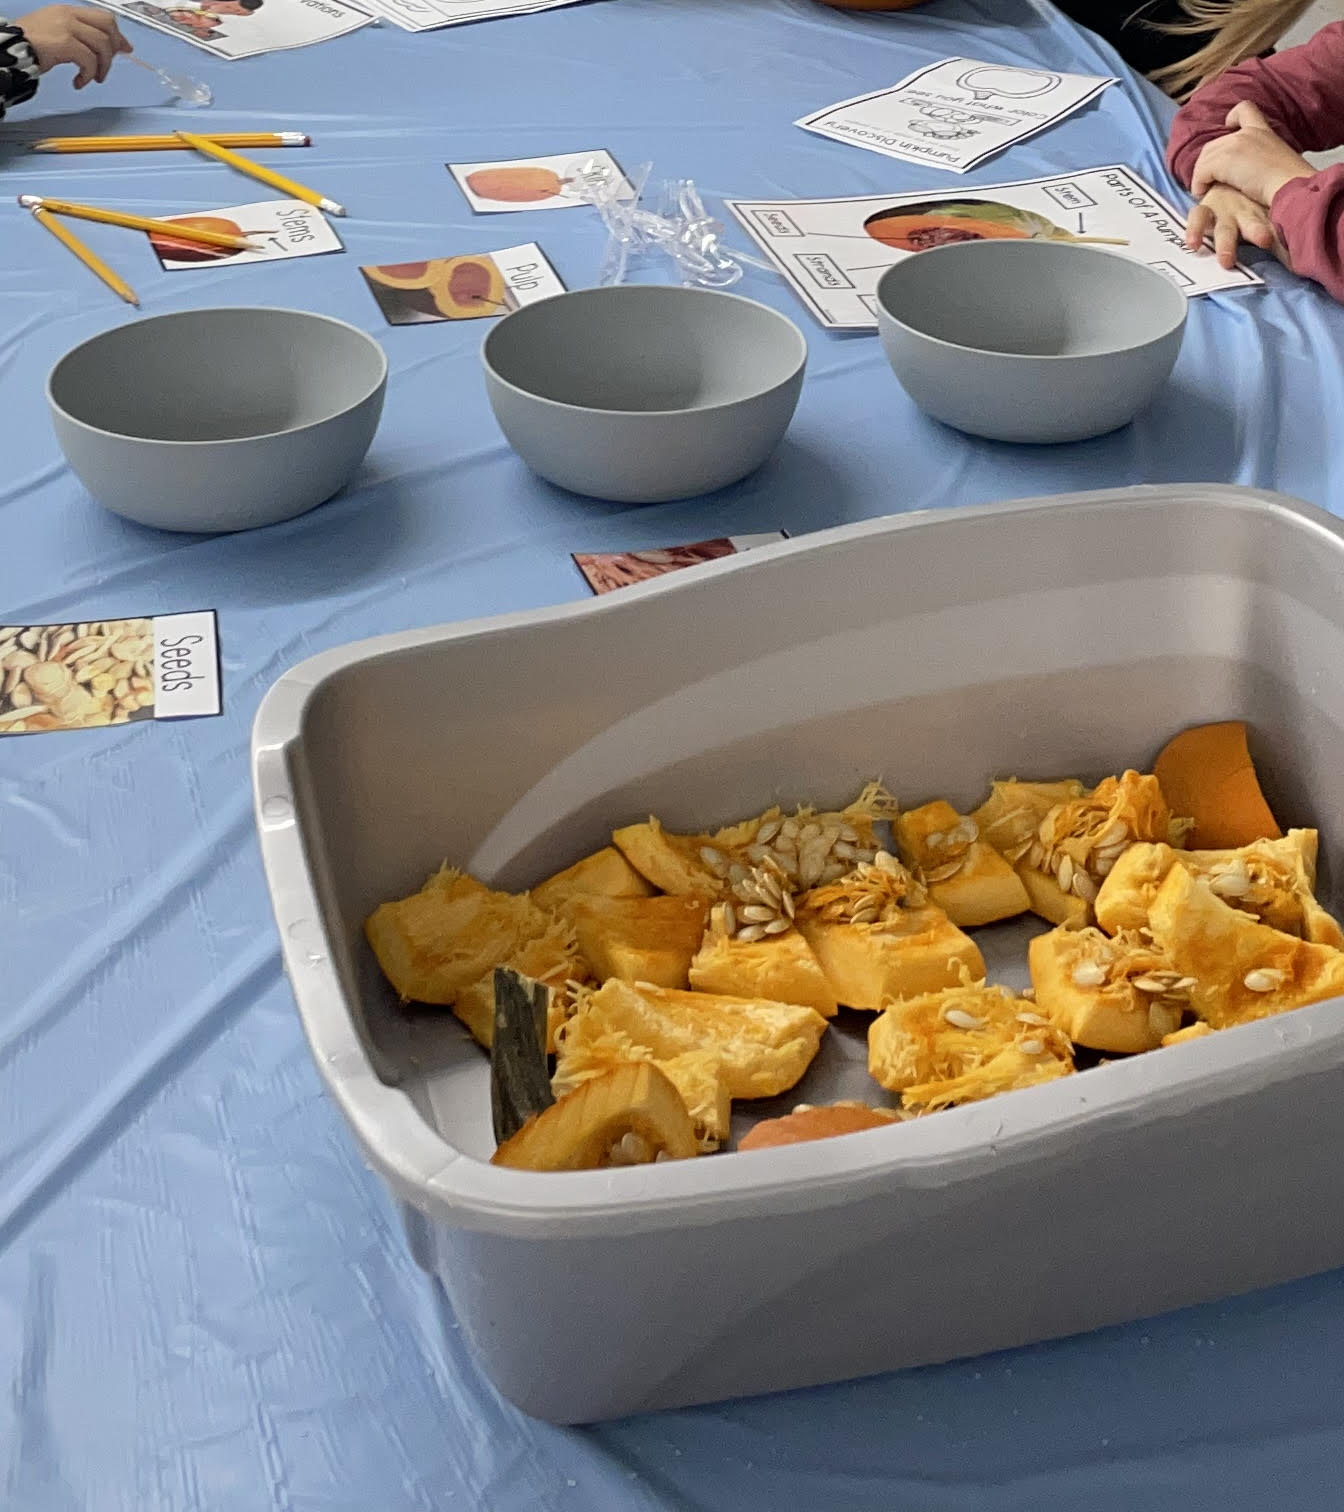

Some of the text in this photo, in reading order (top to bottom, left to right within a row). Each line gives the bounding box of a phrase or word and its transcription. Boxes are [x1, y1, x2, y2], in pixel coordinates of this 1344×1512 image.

[906, 89, 1049, 120] Color what you see
[824, 120, 898, 147] Discovery
[900, 140, 961, 164] Pumpkin
[1054, 186, 1081, 205] Stem
[276, 207, 316, 244] Stems
[1101, 173, 1136, 198] Parts
[1141, 210, 1159, 220] A
[1150, 218, 1197, 255] Pump
[506, 262, 545, 292] Pulp
[806, 255, 841, 287] Strands
[160, 635, 206, 692] Seeds
